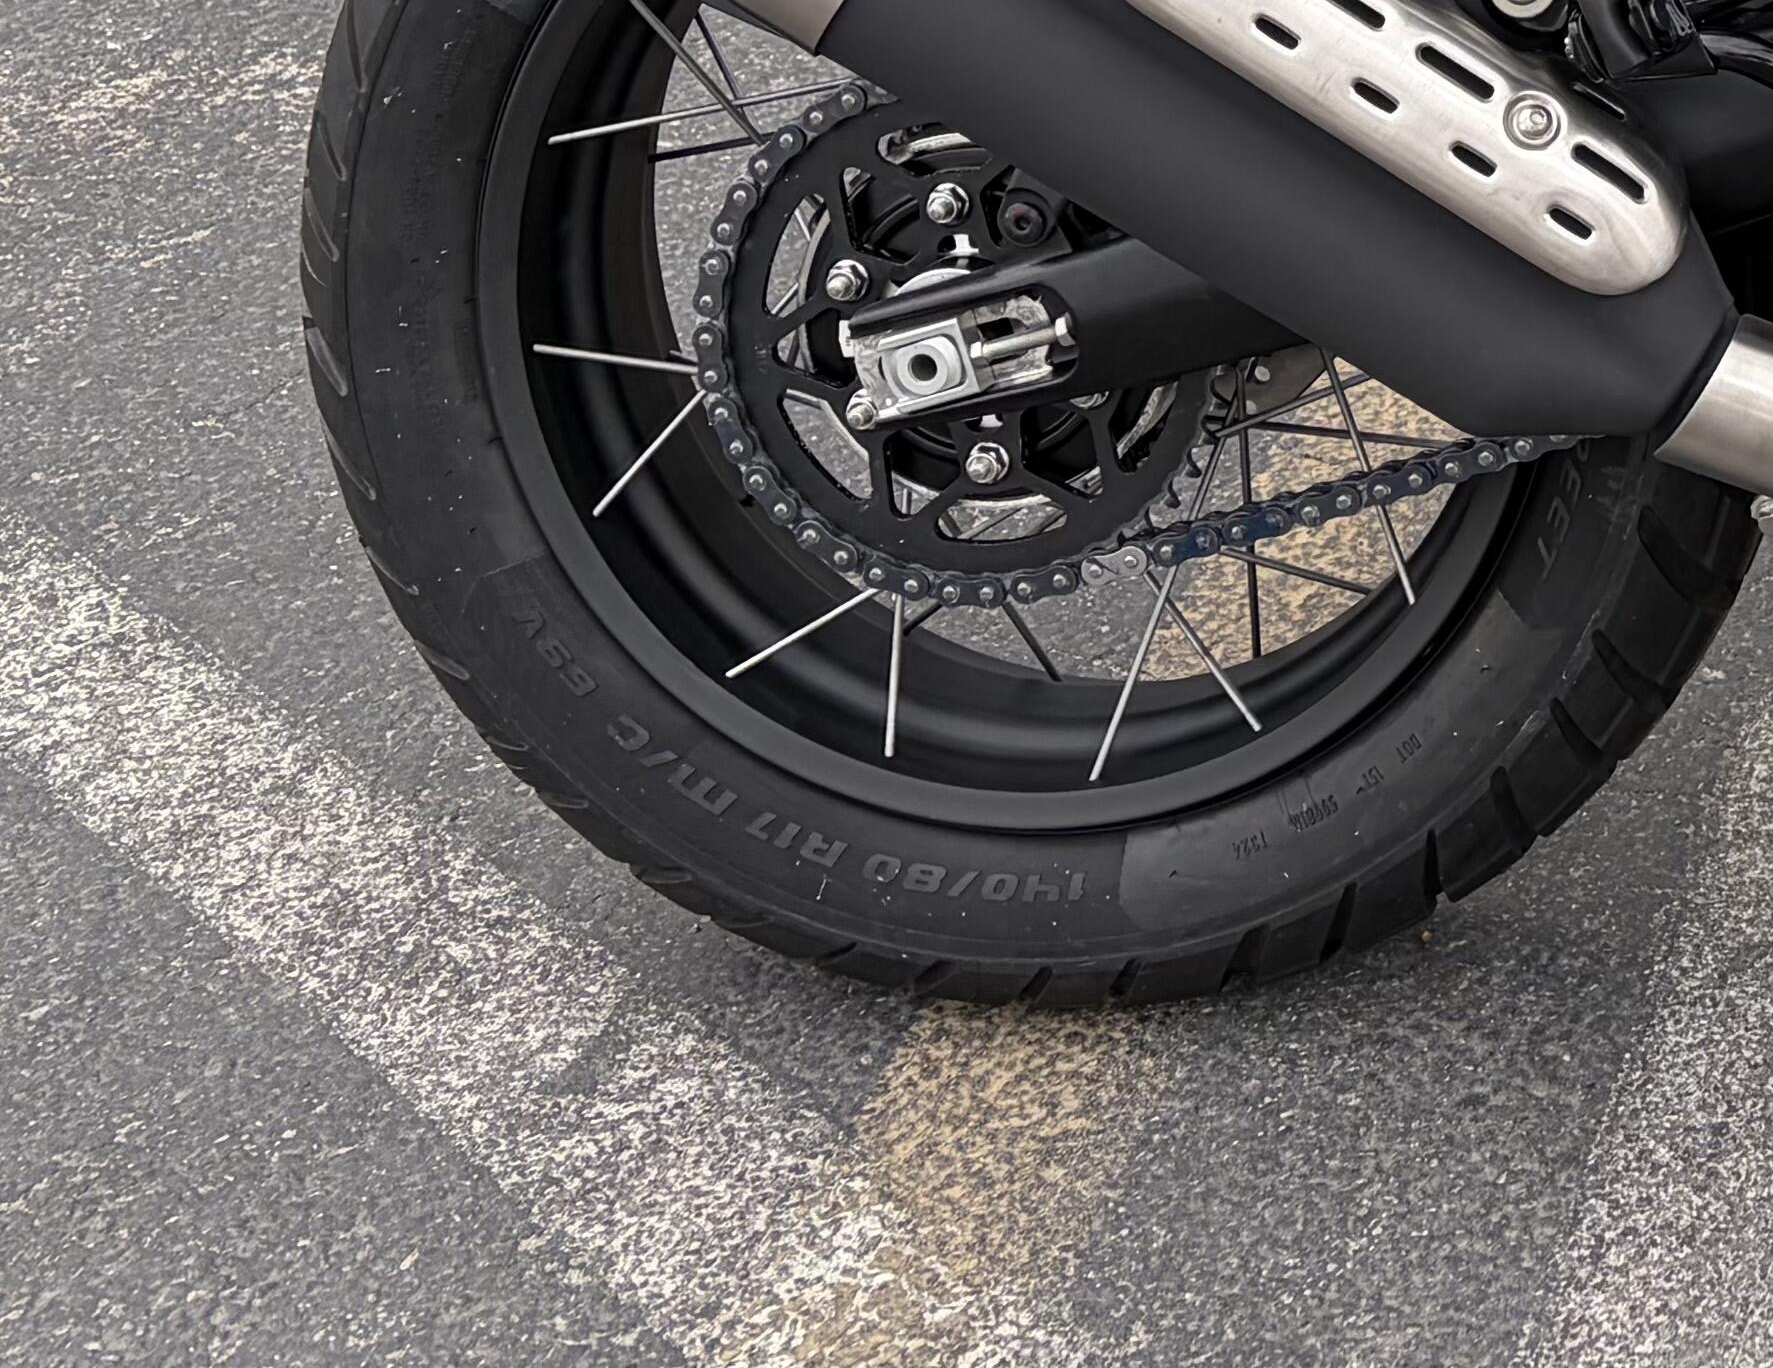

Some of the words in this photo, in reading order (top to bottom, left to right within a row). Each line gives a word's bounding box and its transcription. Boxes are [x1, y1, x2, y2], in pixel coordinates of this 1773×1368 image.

[600, 707, 741, 823] M/C
[1395, 732, 1423, 764] DOT
[744, 803, 847, 871] R17
[858, 846, 1087, 903] 140/80
